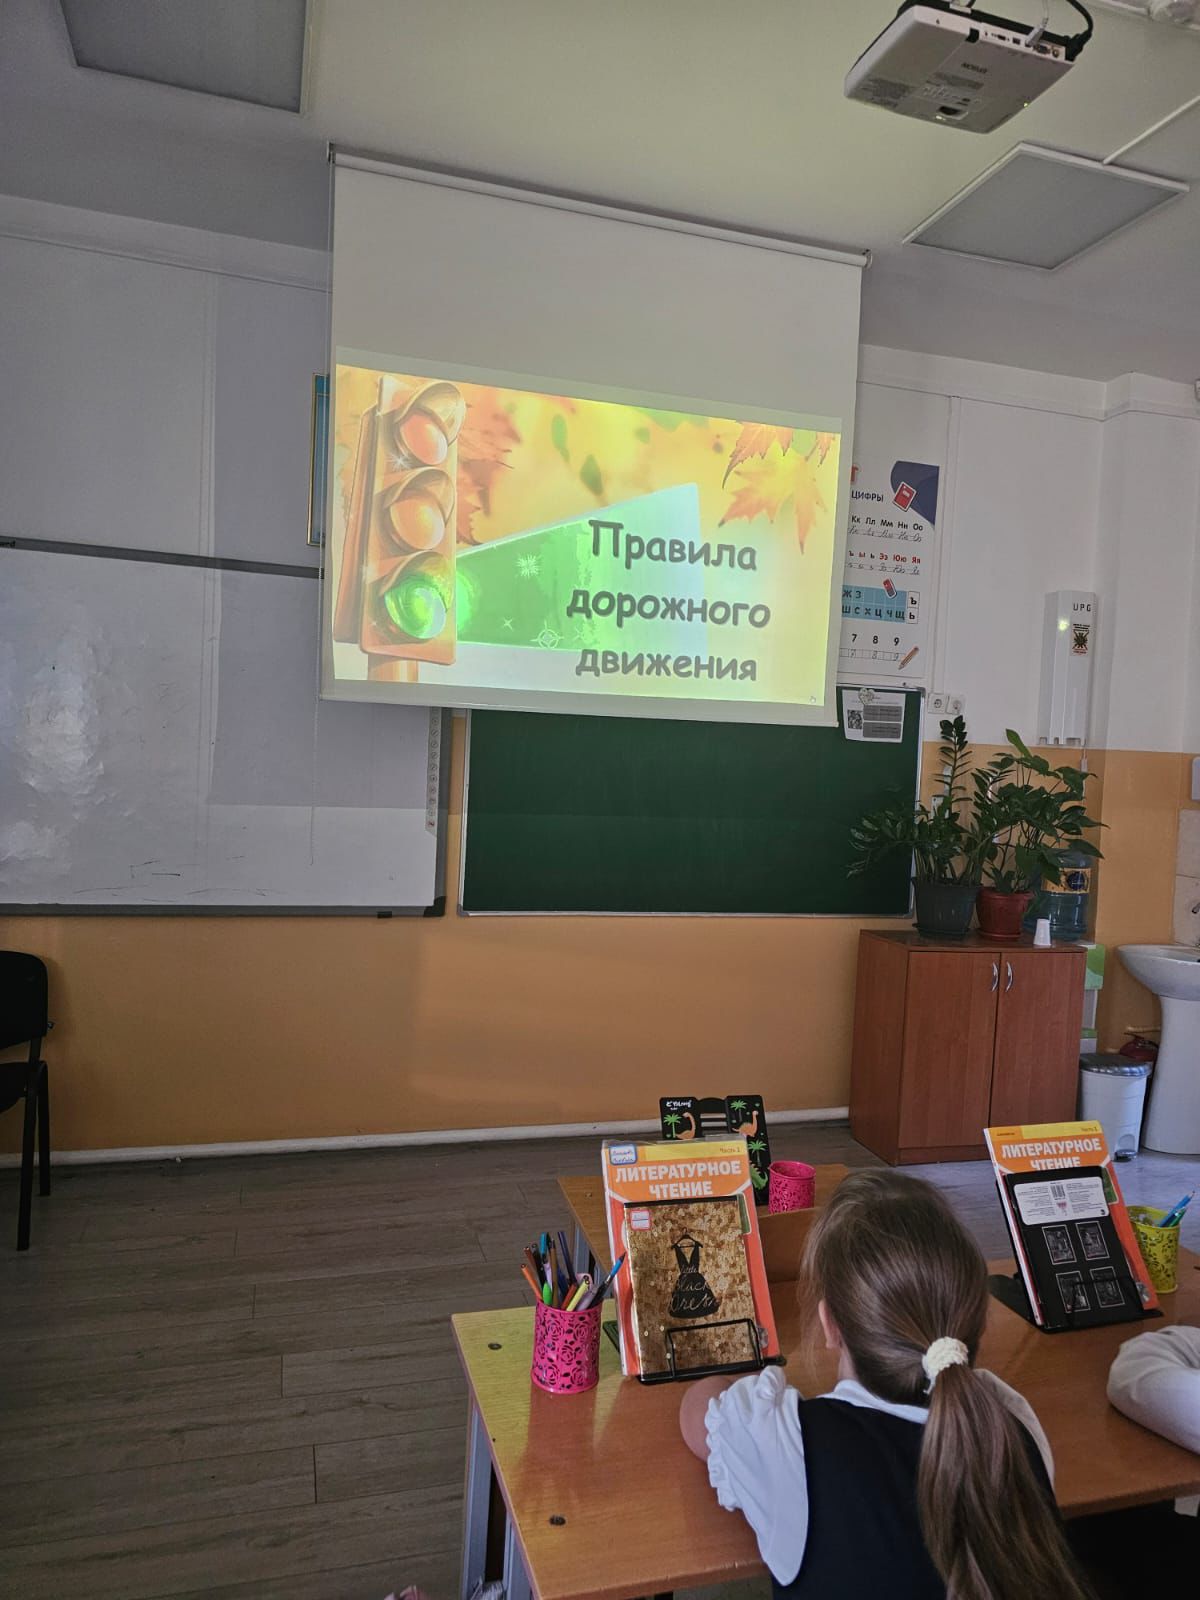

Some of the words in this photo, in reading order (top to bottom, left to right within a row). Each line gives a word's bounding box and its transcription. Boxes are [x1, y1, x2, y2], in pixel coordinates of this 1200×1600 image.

[851, 490, 884, 502] ЦИФРЫ
[851, 515, 861, 524] Кк
[880, 519, 893, 528] Мм
[897, 521, 909, 530] Нн
[588, 519, 757, 571] Правила
[566, 588, 771, 629] дорожного
[851, 633, 858, 643] 7
[872, 635, 879, 645] 8
[893, 636, 900, 646] 9
[575, 648, 757, 682] движения
[1001, 1137, 1103, 1159] ЛИТЕРАТУРНОЕ
[615, 1159, 742, 1183] ЛИТЕРАТУРНОЕ
[1030, 1155, 1081, 1171] ЧТЕНИЕ
[649, 1180, 713, 1200] ЧТЕНИЕ
